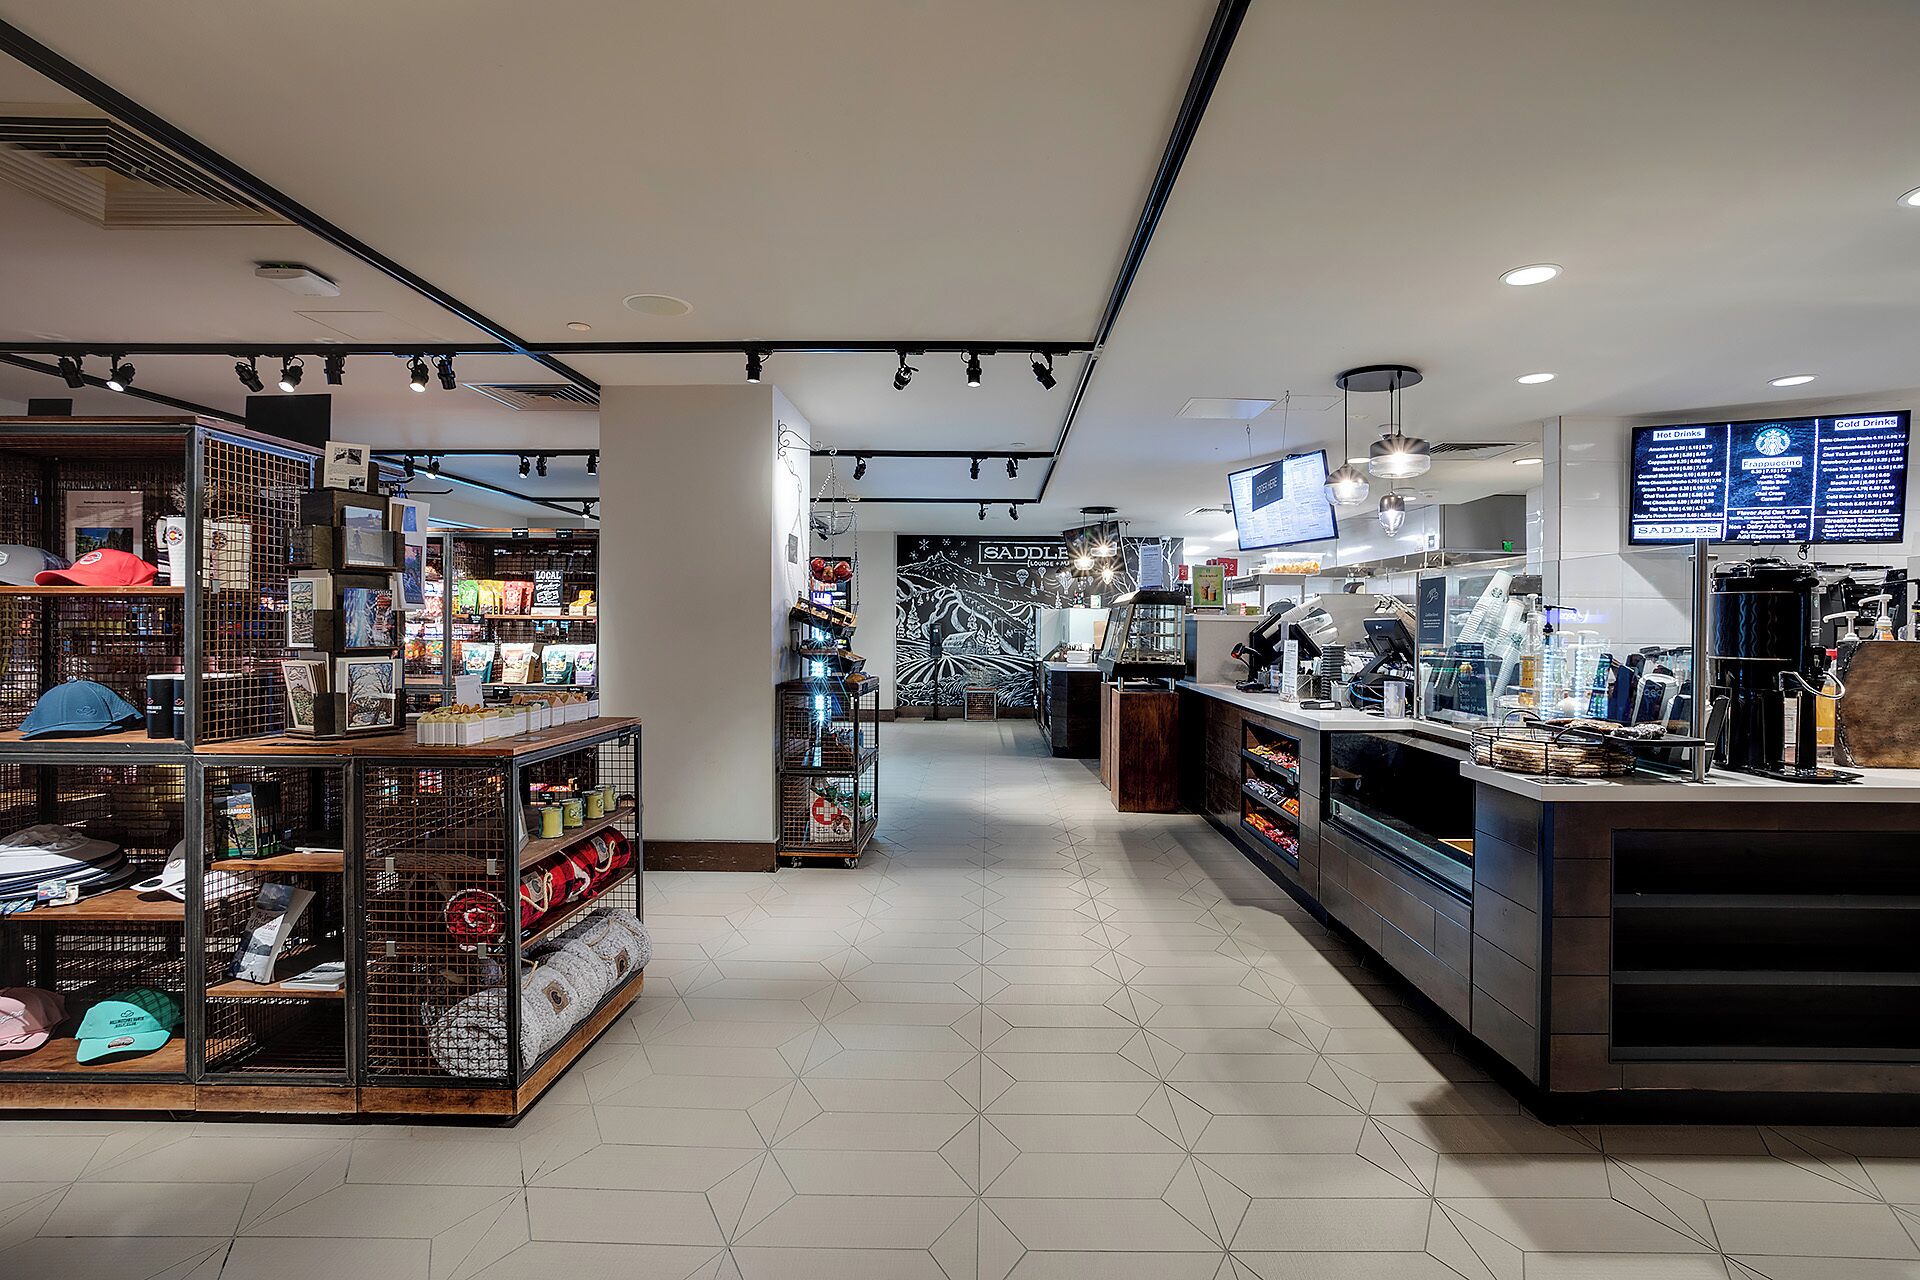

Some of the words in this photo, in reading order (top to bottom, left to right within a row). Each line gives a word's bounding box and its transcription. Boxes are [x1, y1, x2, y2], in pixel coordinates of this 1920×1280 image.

[1864, 419, 1896, 427] Drinks
[1638, 526, 1718, 534] SADDLES
[984, 547, 1069, 559] SADDLE
[535, 571, 561, 580] LOCAL
